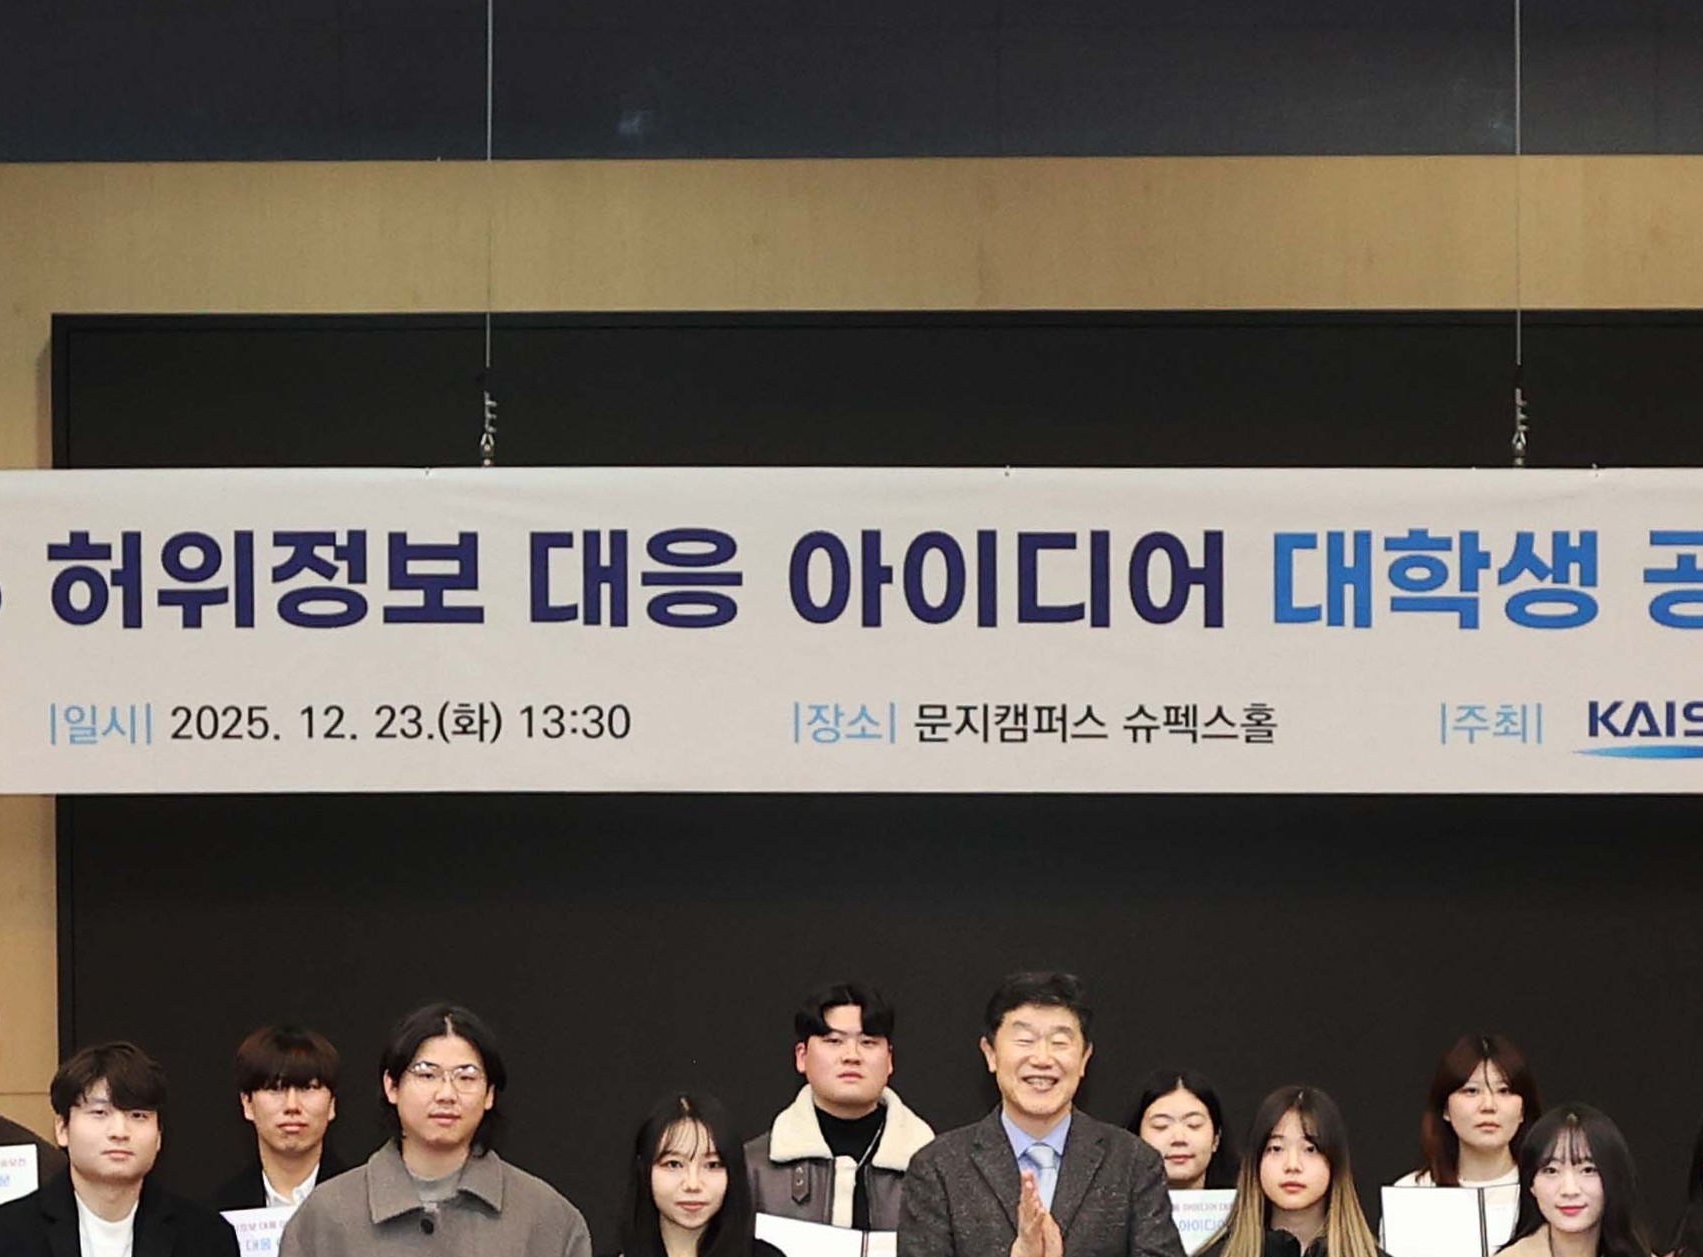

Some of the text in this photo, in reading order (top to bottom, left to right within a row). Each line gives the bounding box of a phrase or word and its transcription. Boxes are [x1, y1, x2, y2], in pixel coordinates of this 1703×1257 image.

[47, 530, 484, 629] 허위정보
[530, 528, 743, 628] 대응
[789, 530, 1224, 628] 아이디어
[1274, 529, 1598, 629] 대학생
[170, 704, 281, 740] 2025.
[301, 705, 358, 740] 12.
[374, 700, 503, 744] 23.(화)
[520, 704, 631, 739] 13:30
[914, 703, 1109, 743] 문지캠퍼스
[1122, 702, 1278, 744] 슈펙스홀
